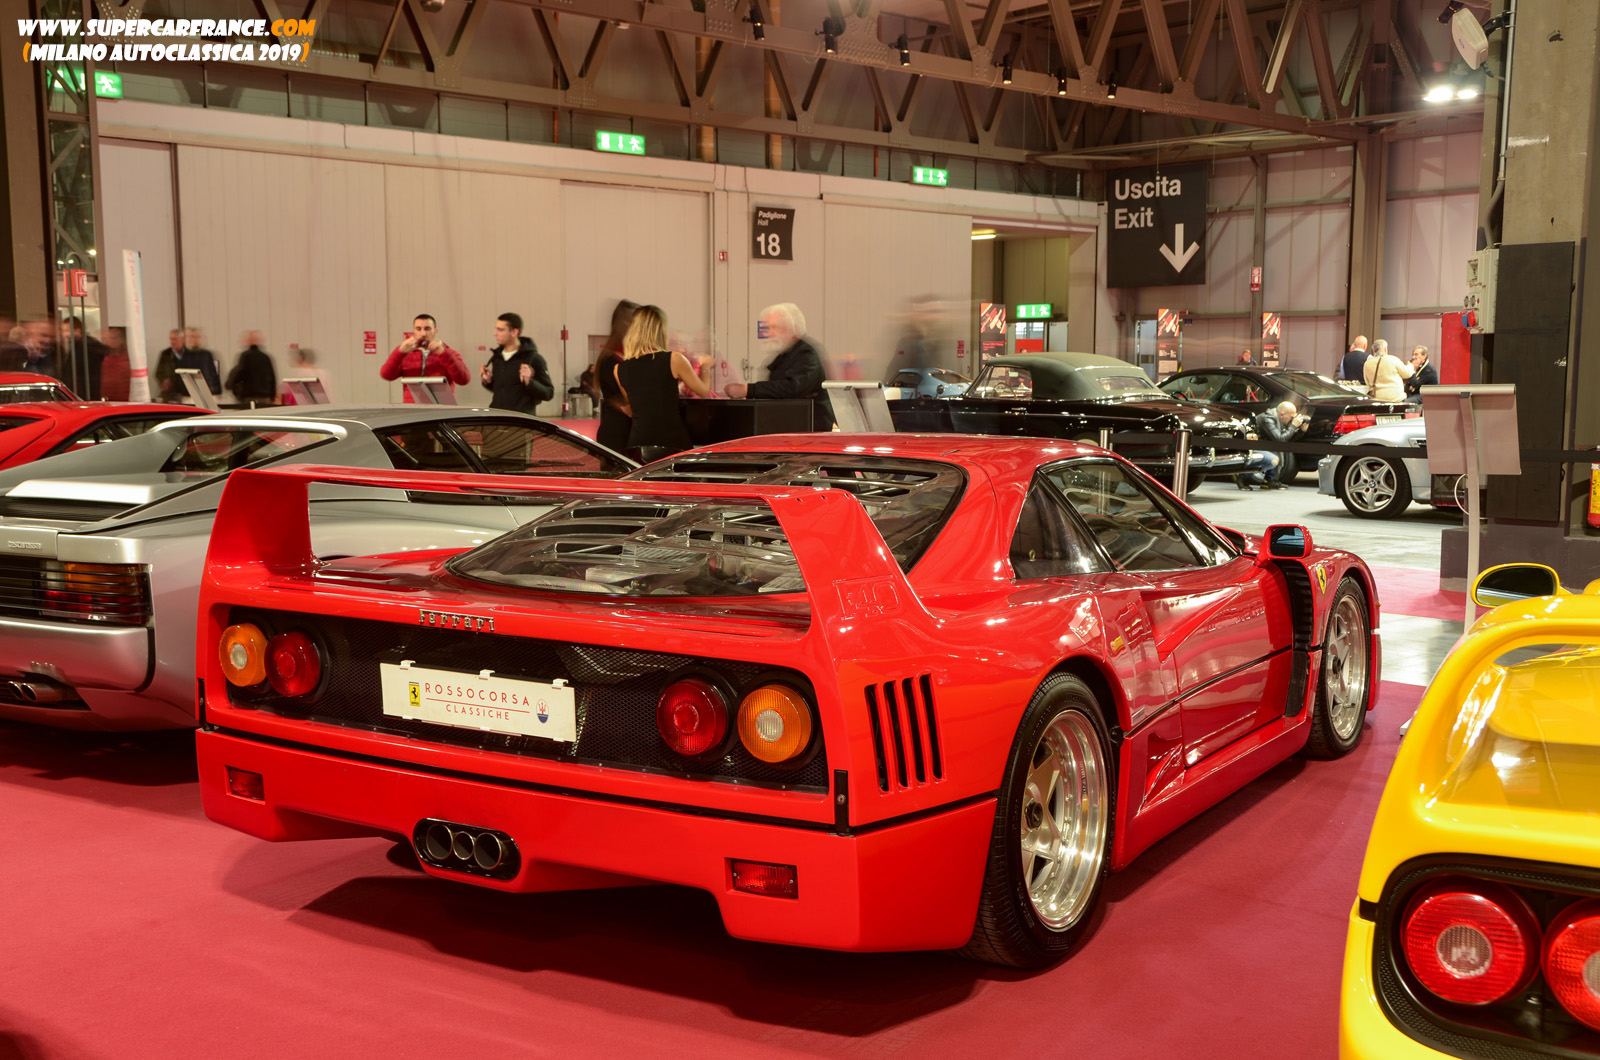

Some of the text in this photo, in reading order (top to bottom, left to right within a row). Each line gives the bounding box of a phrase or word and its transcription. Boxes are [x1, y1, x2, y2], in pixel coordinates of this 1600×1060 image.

[1115, 175, 1182, 200] Uscita
[758, 210, 787, 219] Padiglione
[1114, 206, 1154, 230] Exit
[756, 232, 781, 257] 18
[832, 575, 899, 621] F40
[419, 609, 495, 631] Ferrari
[424, 682, 530, 707] ROSSOCORSA
[445, 703, 510, 721] CLASSICHE
